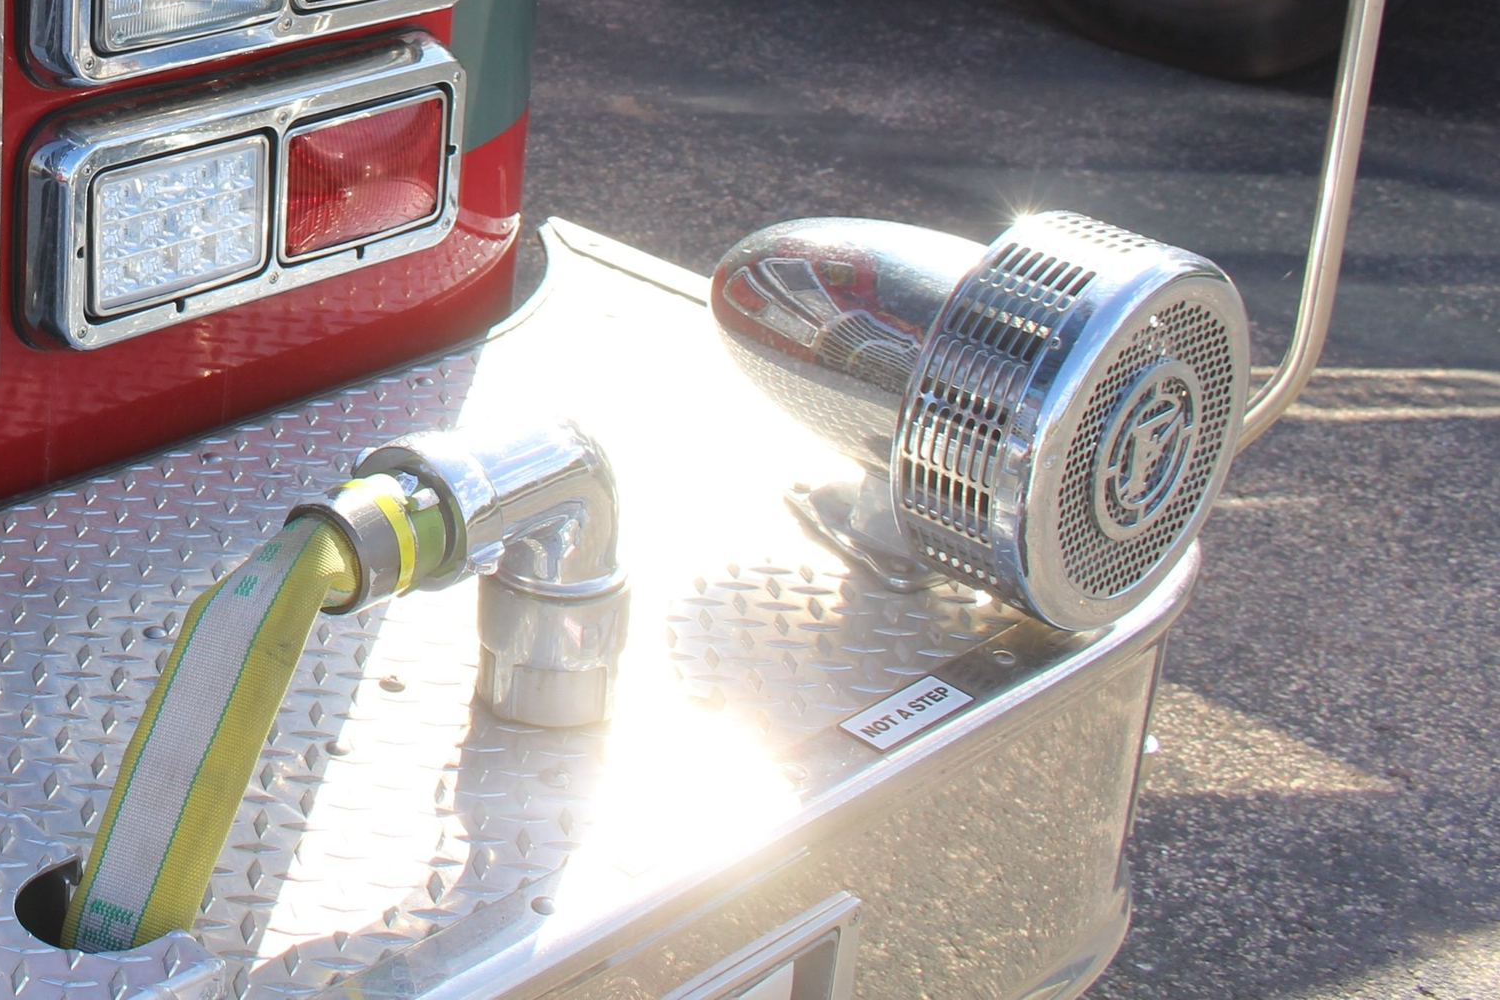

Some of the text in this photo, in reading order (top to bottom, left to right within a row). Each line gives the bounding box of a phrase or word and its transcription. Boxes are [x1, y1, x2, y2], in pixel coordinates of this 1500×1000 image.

[859, 686, 949, 738] NOT A STEP
